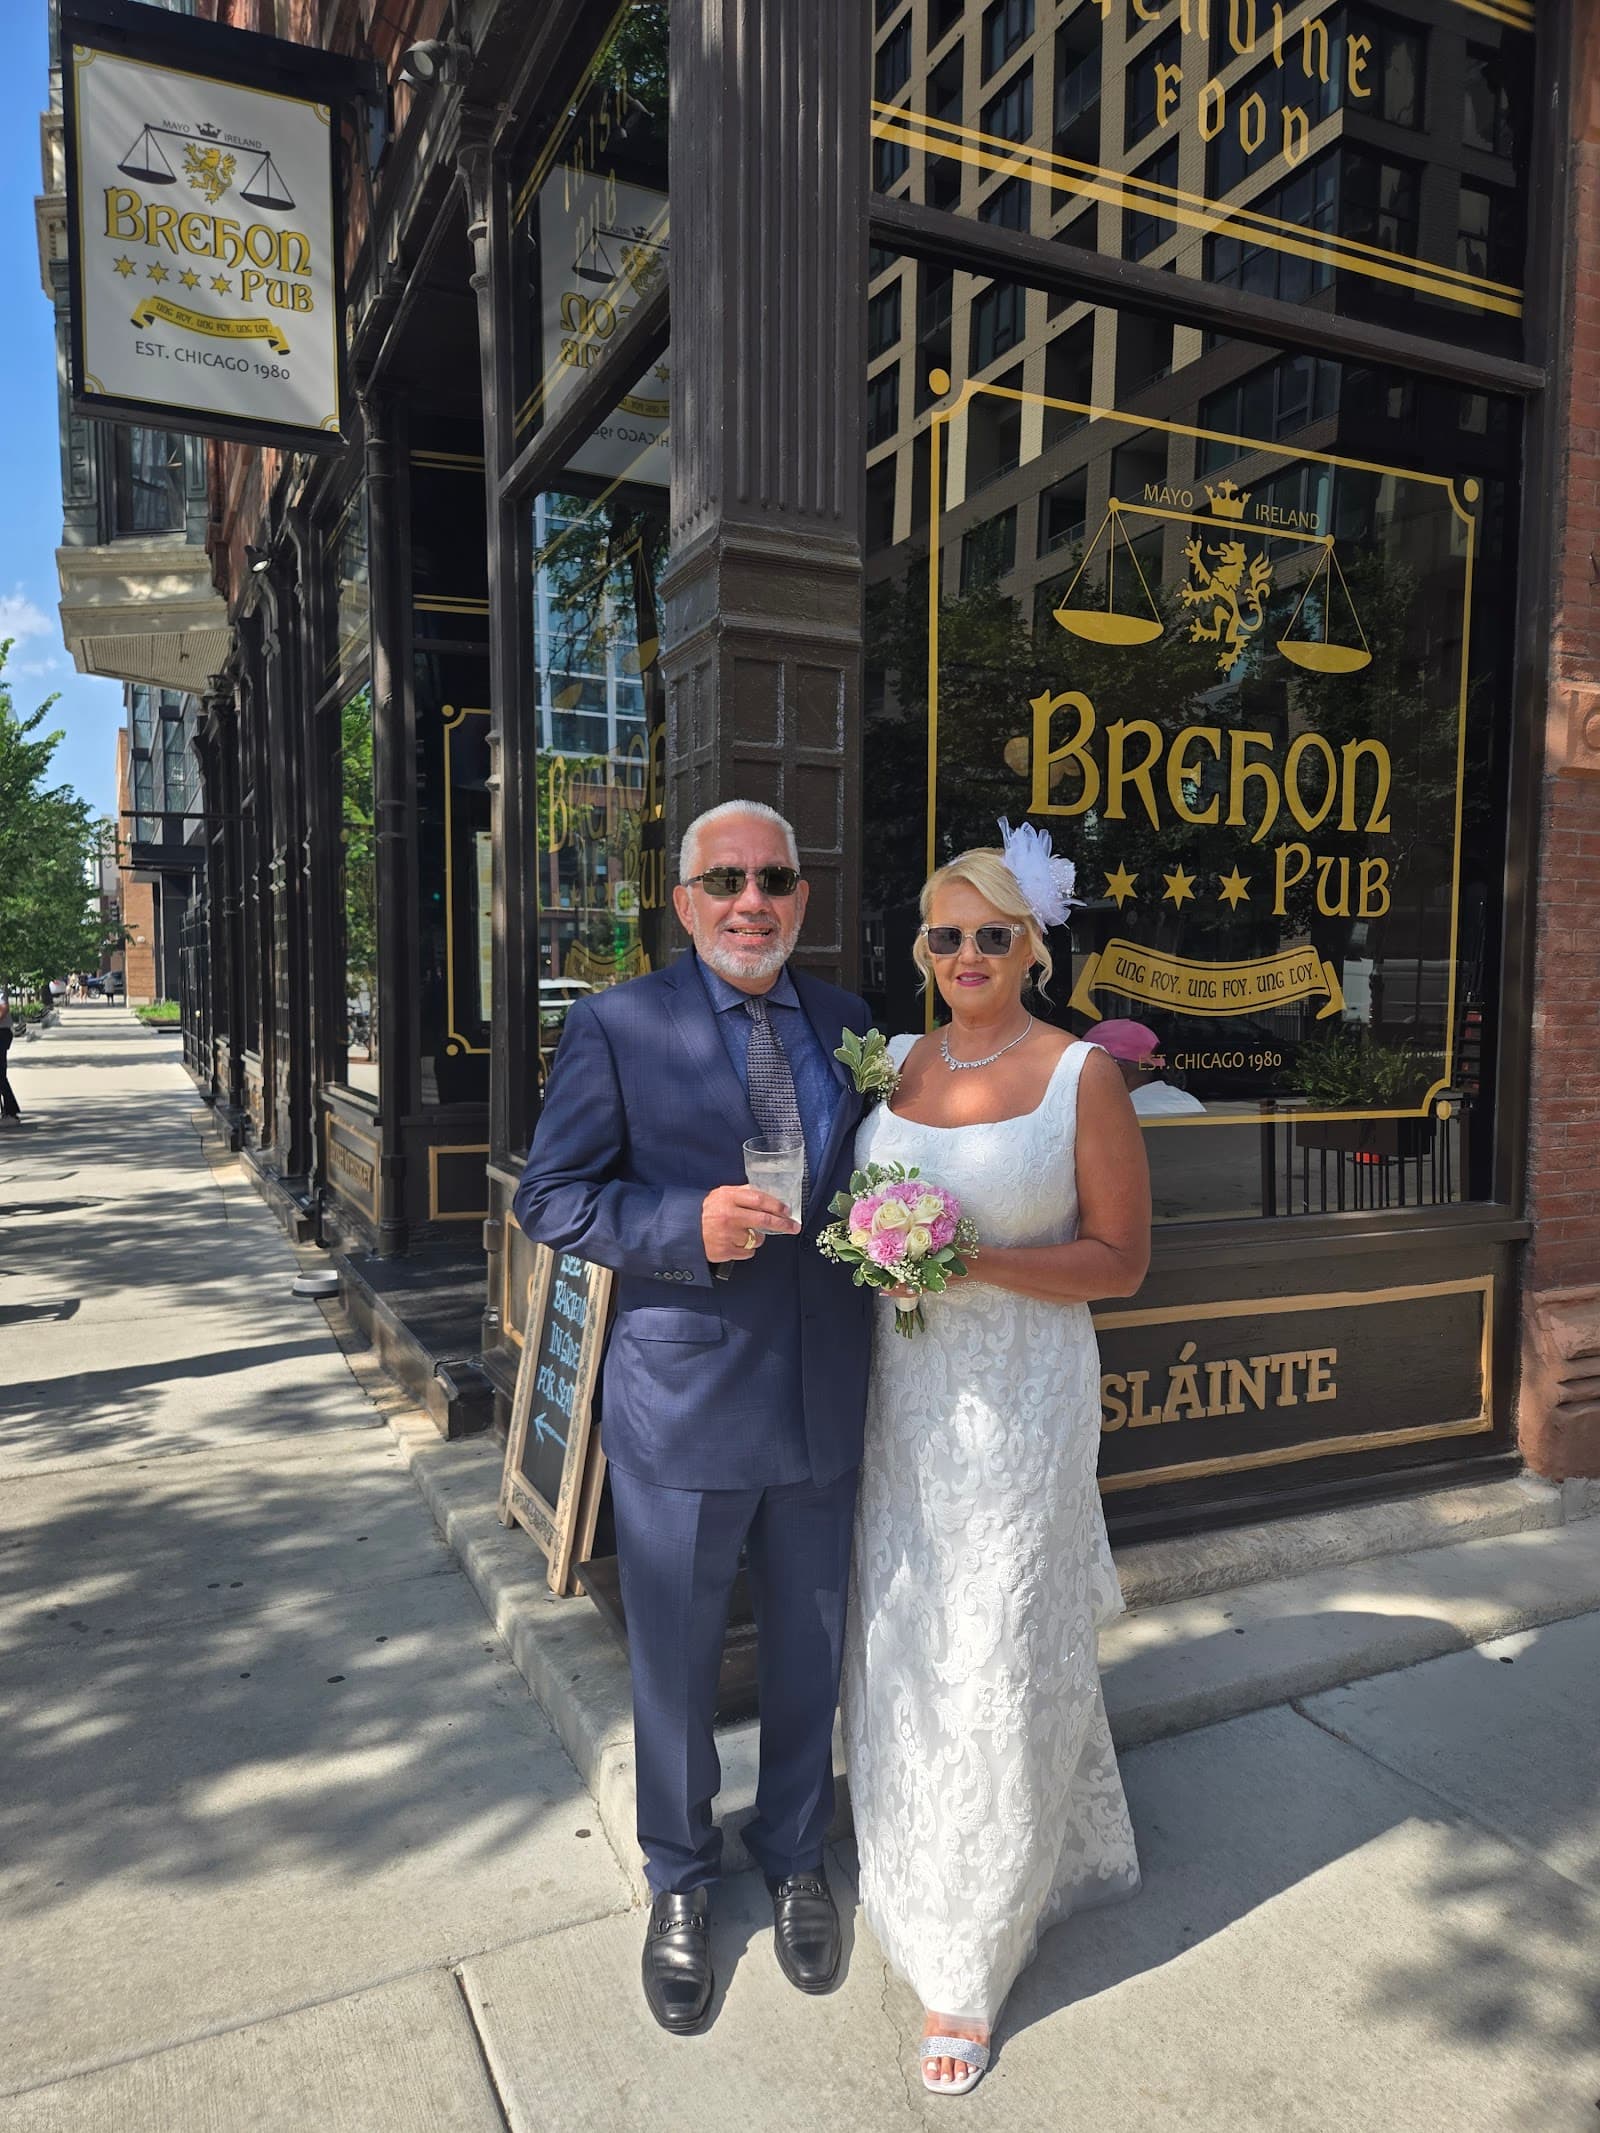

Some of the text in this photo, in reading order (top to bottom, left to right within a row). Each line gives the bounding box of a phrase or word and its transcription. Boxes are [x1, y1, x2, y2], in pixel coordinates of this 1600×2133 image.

[162, 119, 262, 149] MAYO IRELAND
[1154, 62, 1309, 168] FOOD
[103, 186, 312, 277] BREHON
[241, 269, 314, 313] PUB
[135, 340, 290, 380] EST. CHICAGO 1980
[1143, 482, 1321, 531] MAYO IRELAND
[1026, 688, 1392, 843] BREHON
[1271, 841, 1391, 918] PUB
[1114, 956, 1147, 984] UNG
[1150, 970, 1181, 995] ROY.
[1188, 978, 1217, 998] UNG
[1257, 971, 1285, 993] UNG
[1138, 1050, 1282, 1072] EST. CHICAGO 1980
[1101, 1341, 1338, 1432] SLÁINTE
